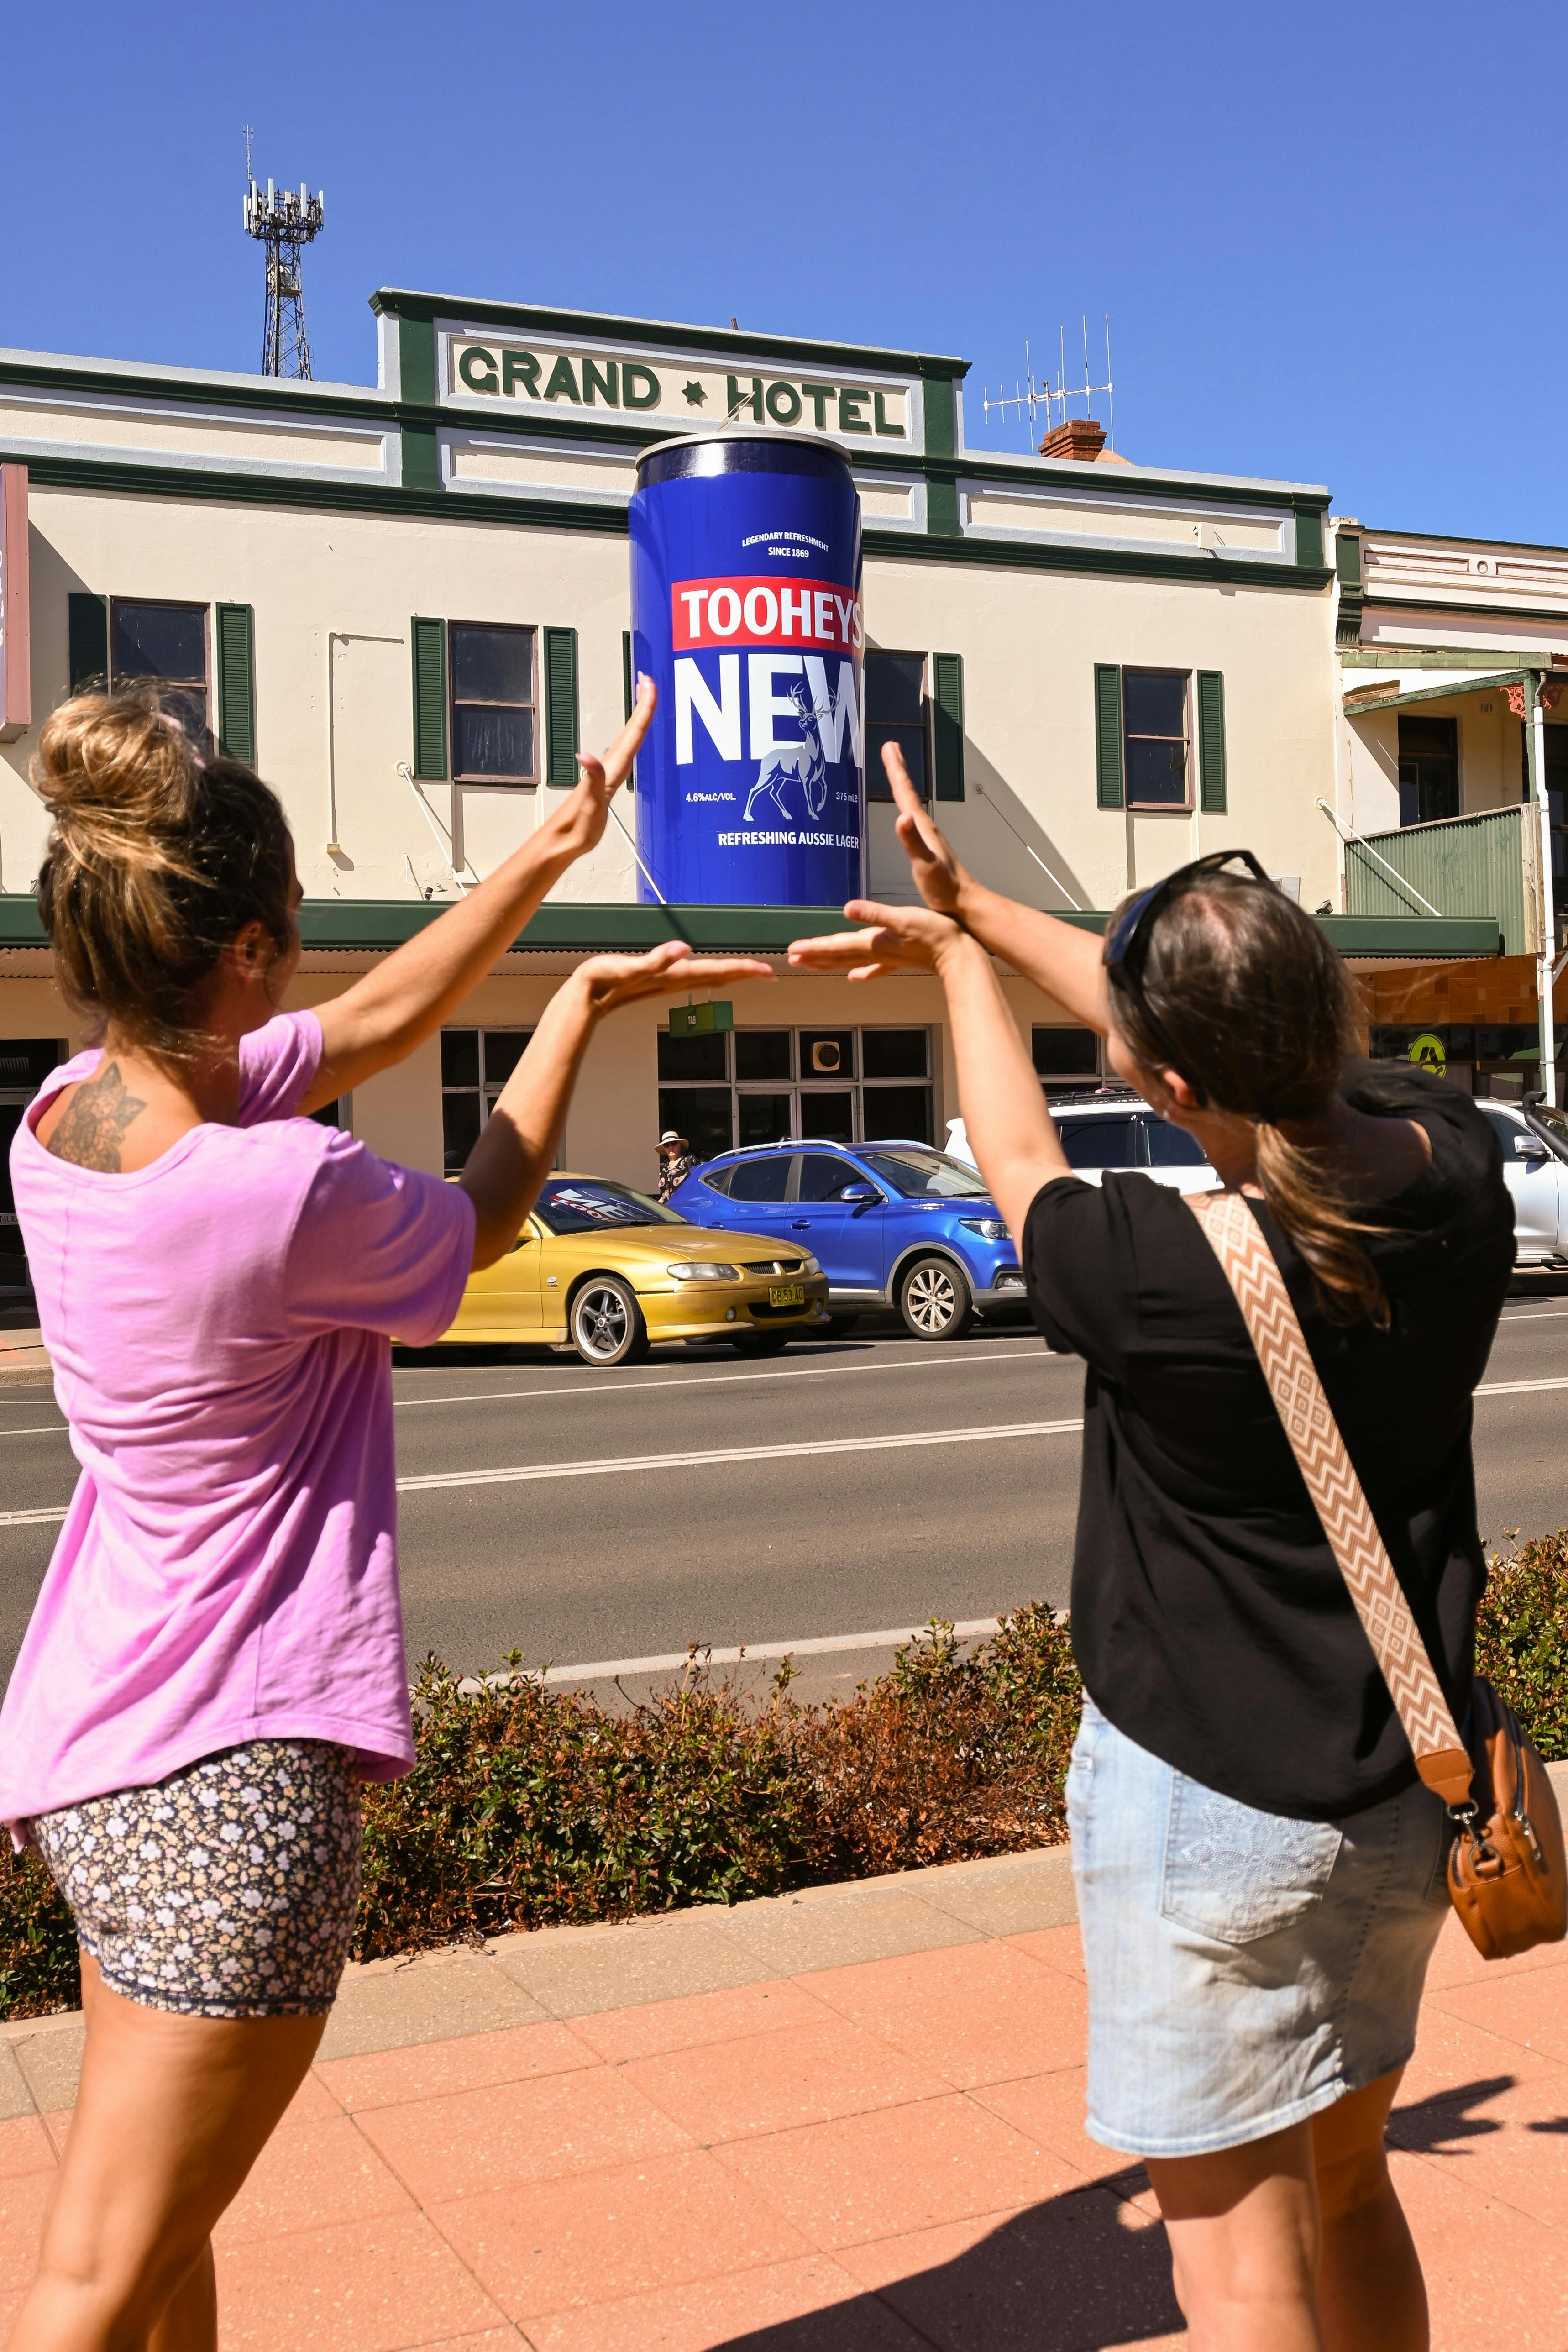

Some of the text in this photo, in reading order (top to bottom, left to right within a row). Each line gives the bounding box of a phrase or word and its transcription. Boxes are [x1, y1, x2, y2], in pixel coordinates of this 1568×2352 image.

[459, 346, 904, 435] GRAND HOTEL
[742, 532, 829, 552] LEGENDARY REFRESHMENT
[768, 547, 809, 558] SINCE 1869
[681, 586, 862, 648] TOOHEYS
[674, 653, 865, 768] NEW
[836, 792, 847, 801] 375
[718, 832, 859, 849] REFRESHING AUSSIE LAGER
[688, 1015, 696, 1025] TAB
[772, 1290, 781, 1302] DB
[783, 1289, 792, 1301] 53
